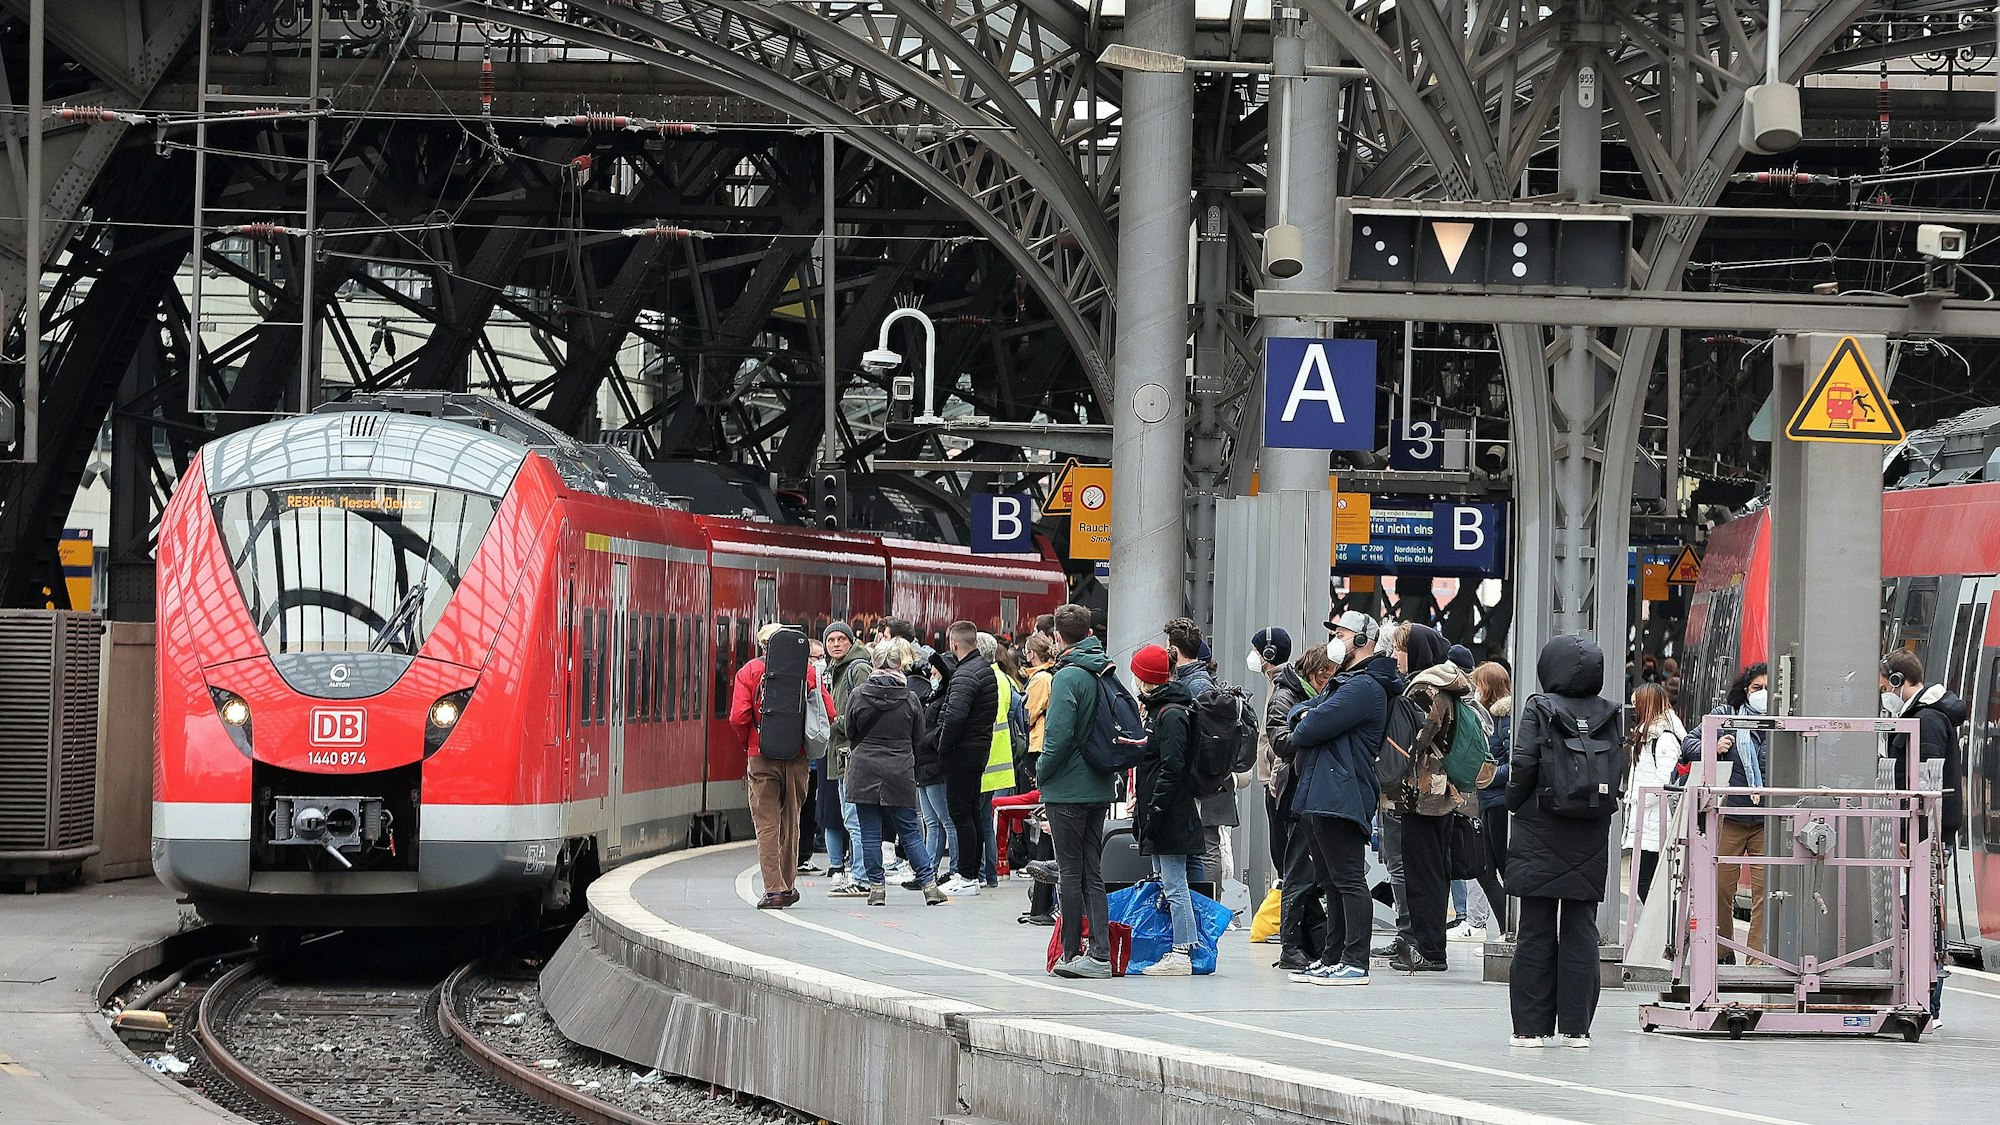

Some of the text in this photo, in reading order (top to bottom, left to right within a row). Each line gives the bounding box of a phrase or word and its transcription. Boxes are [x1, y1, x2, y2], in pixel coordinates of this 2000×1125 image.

[1580, 74, 1594, 83] 955
[1281, 344, 1346, 423] A
[1409, 421, 1434, 460] 3
[992, 496, 1022, 541] B
[1080, 523, 1112, 532] Rauch
[1387, 524, 1410, 534] nicht
[1453, 506, 1485, 551] B
[1394, 554, 1413, 563] Berlin
[317, 714, 359, 739] DB
[307, 751, 367, 765] 1440 874
